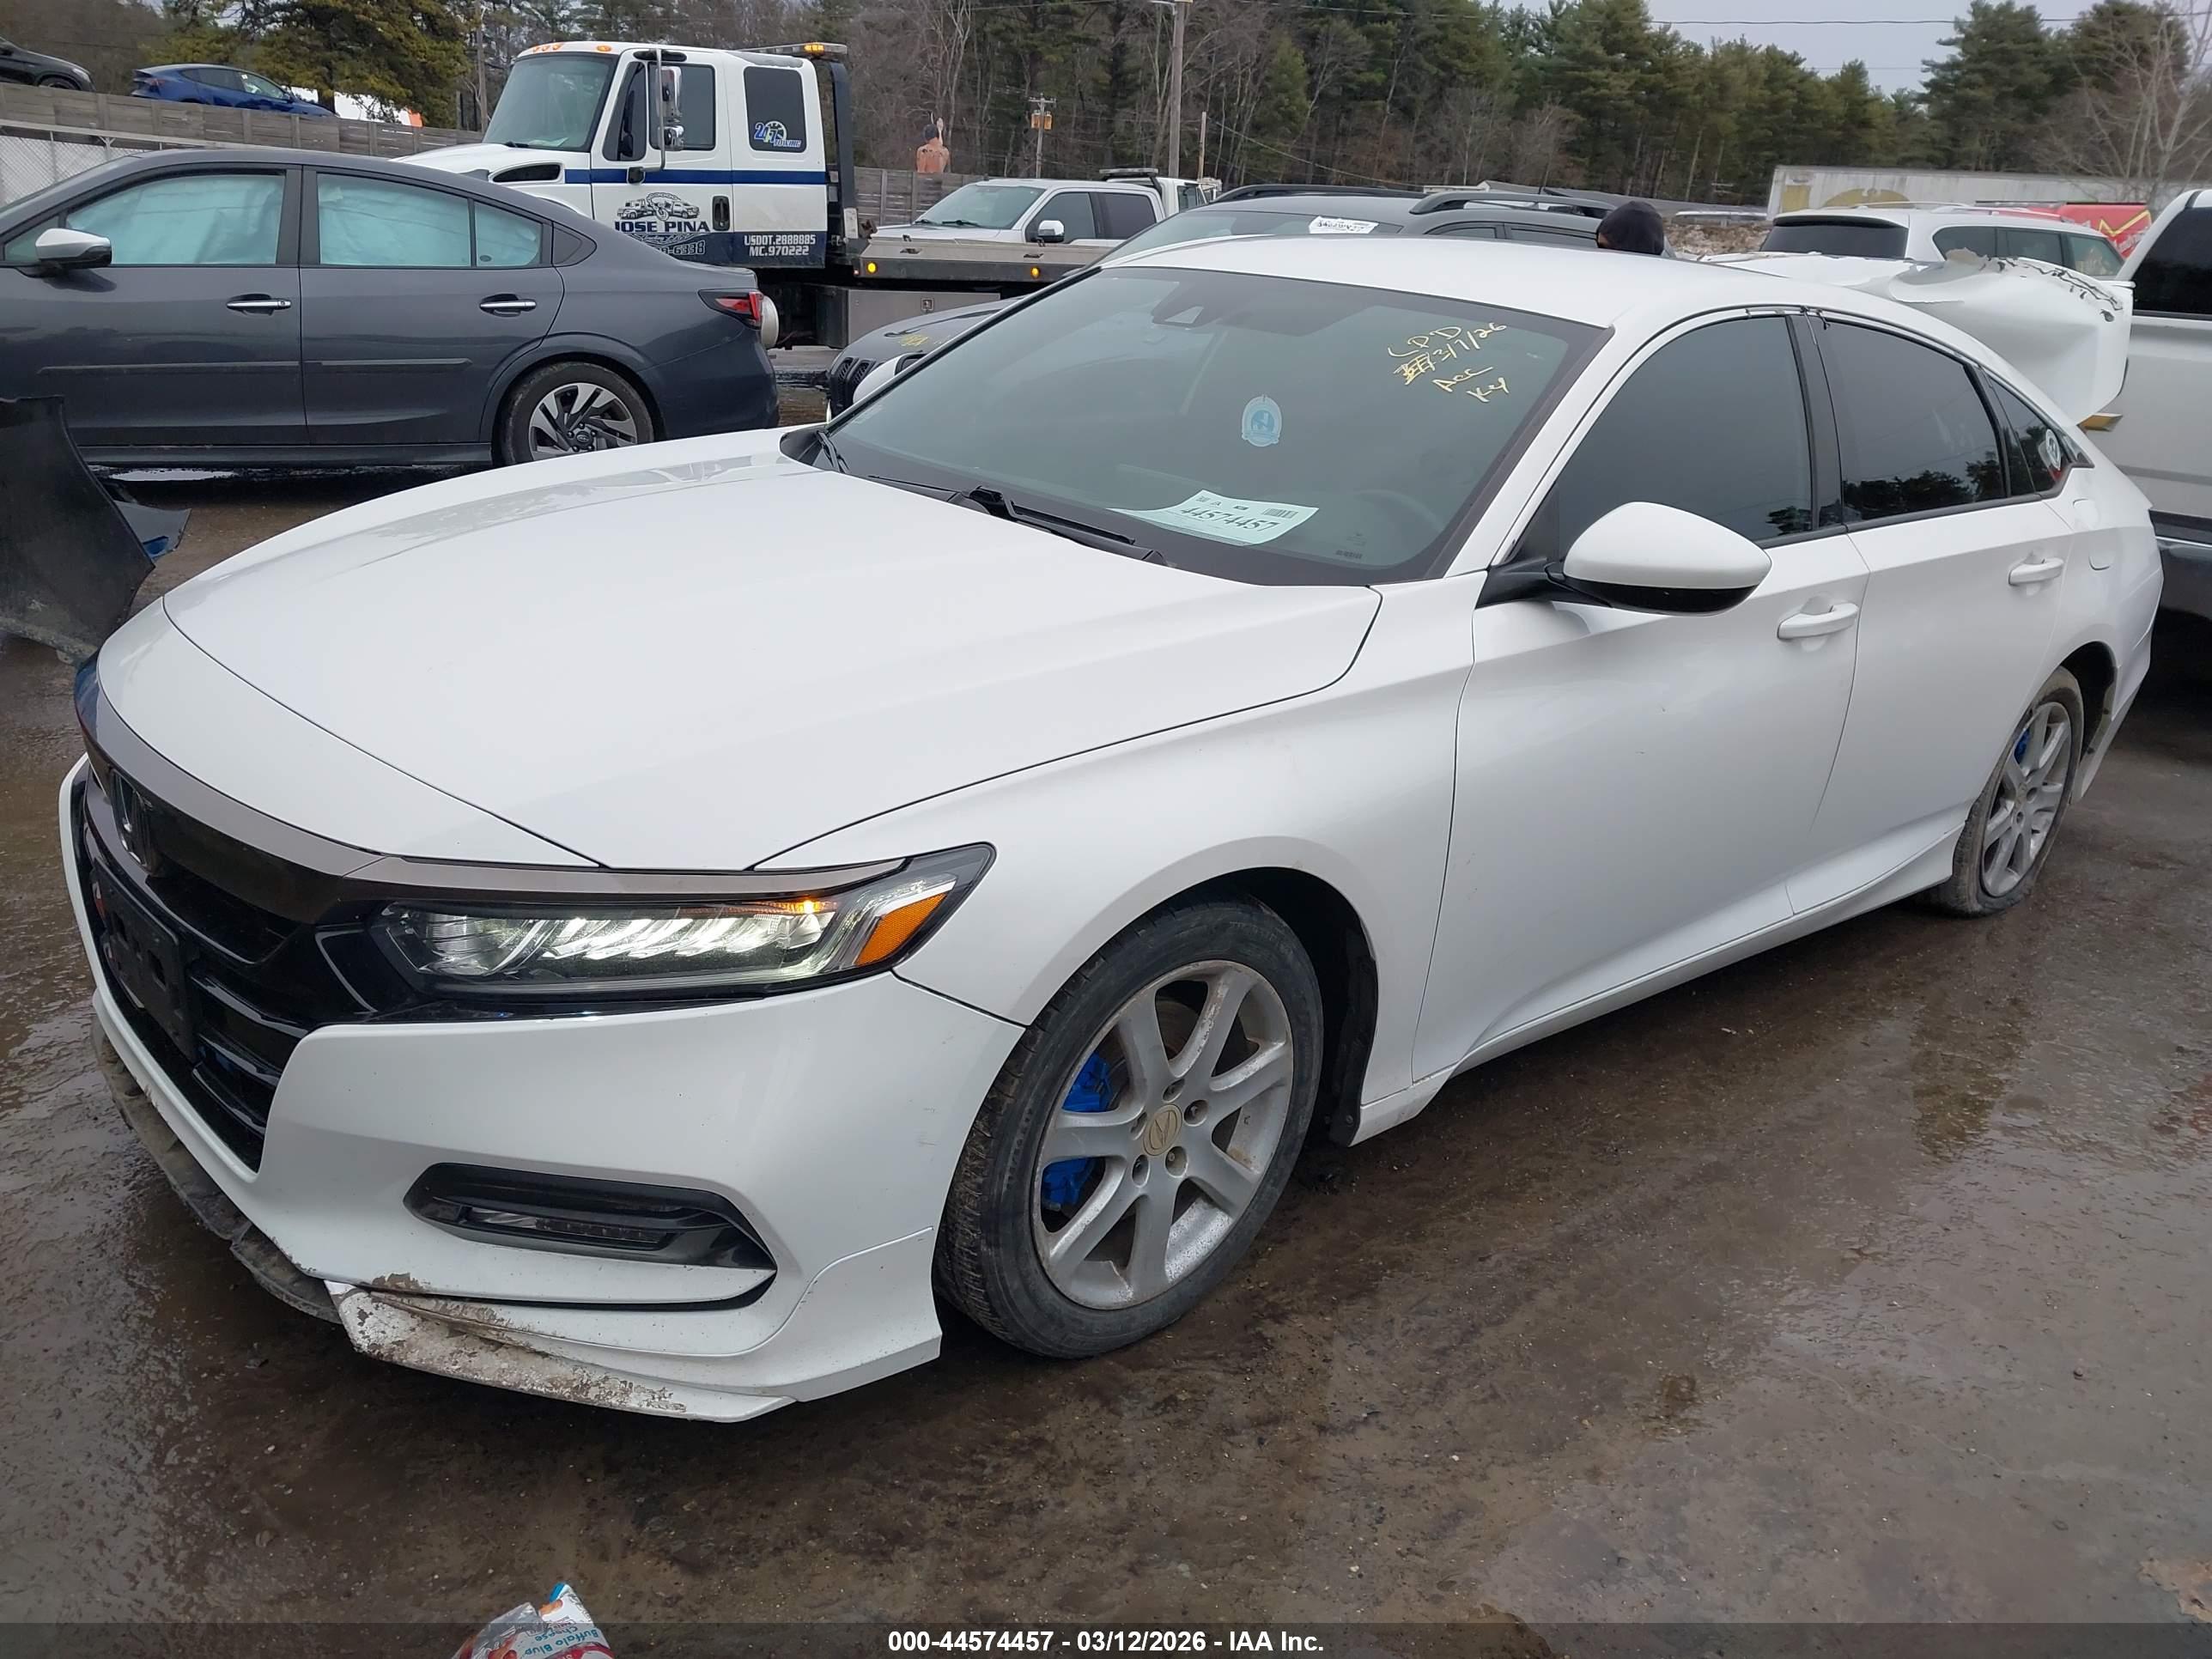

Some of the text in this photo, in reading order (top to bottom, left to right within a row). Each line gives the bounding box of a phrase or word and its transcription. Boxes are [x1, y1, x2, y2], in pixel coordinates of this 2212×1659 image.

[664, 221, 711, 233] PINA
[749, 245, 810, 257] MC.970222
[1180, 507, 1281, 532] 44574457
[556, 1629, 599, 1645] Buffalo
